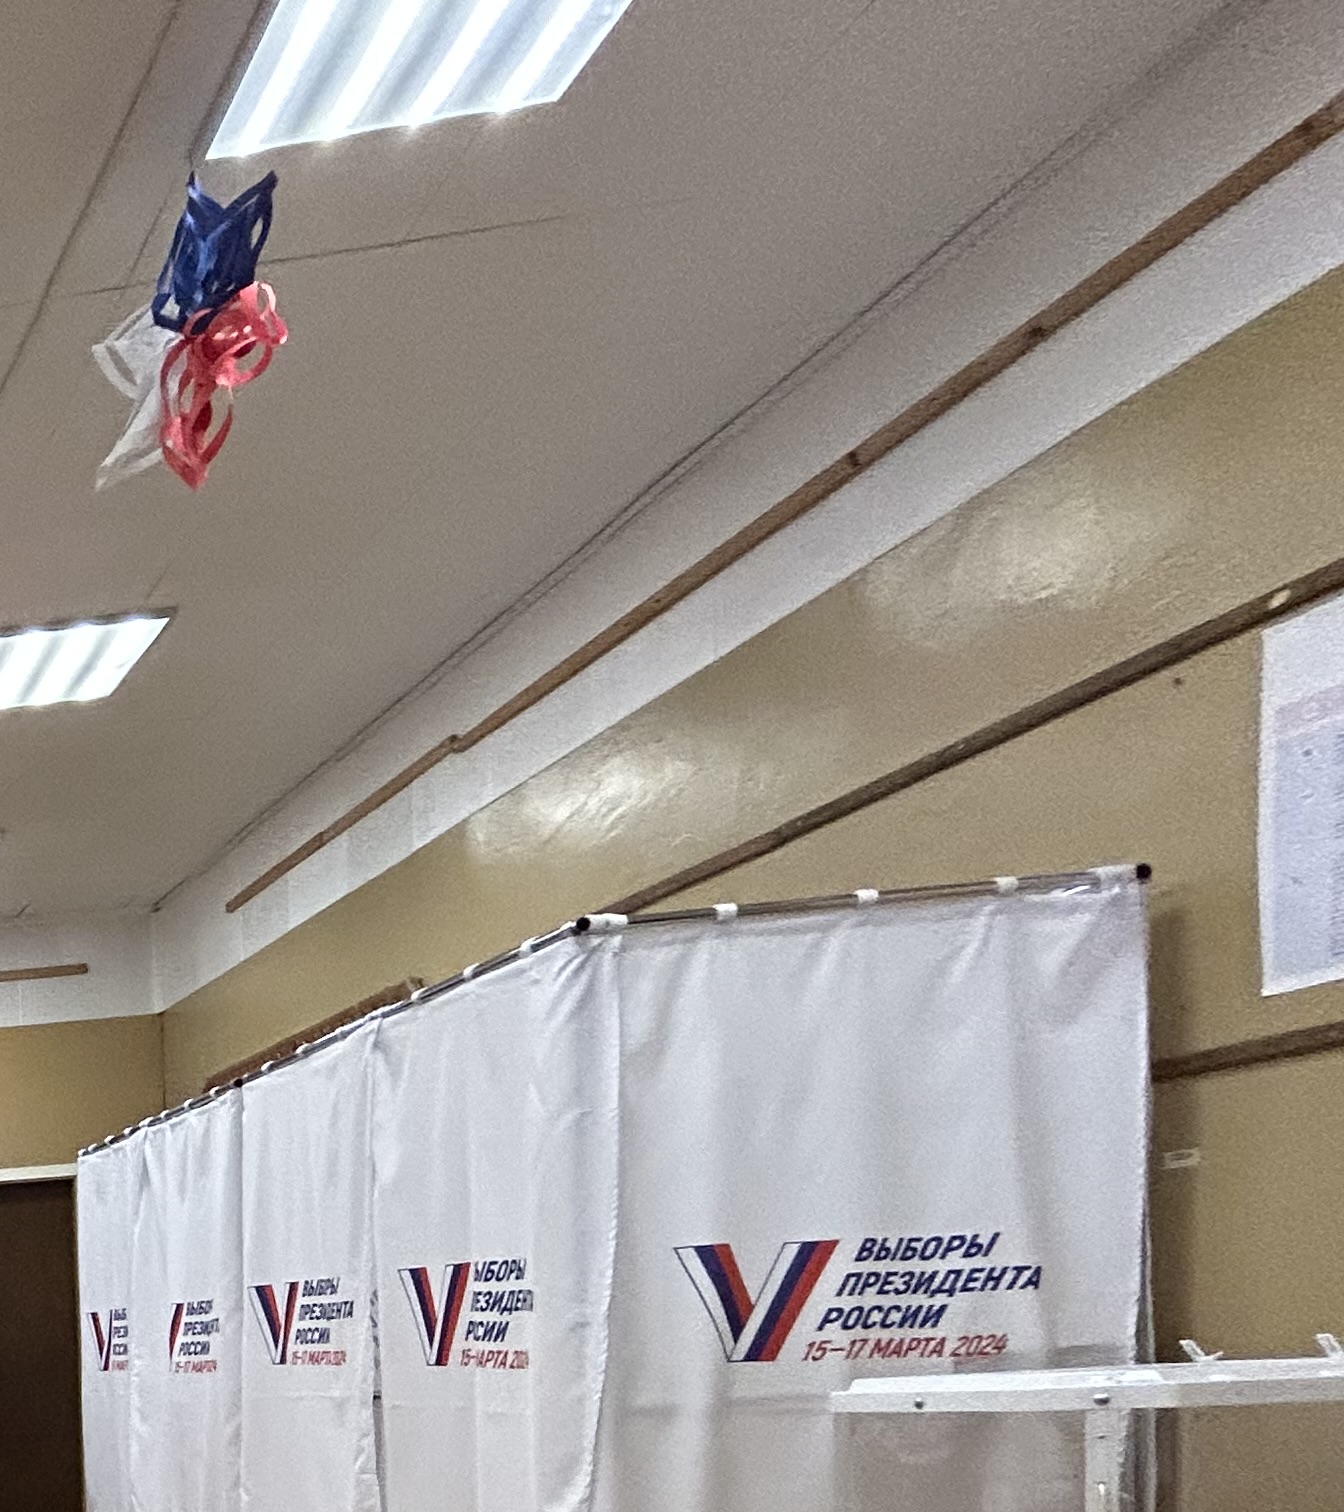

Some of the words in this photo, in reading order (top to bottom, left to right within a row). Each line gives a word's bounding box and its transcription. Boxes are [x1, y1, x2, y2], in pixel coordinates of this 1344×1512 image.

[855, 1232, 1000, 1262] ВЫБОРЫ
[835, 1265, 1043, 1298] ПРЕЗИДЕНТА
[816, 1304, 949, 1332] РОССИИ
[868, 1336, 947, 1360] МАРТА
[950, 1334, 1010, 1358] 2024
